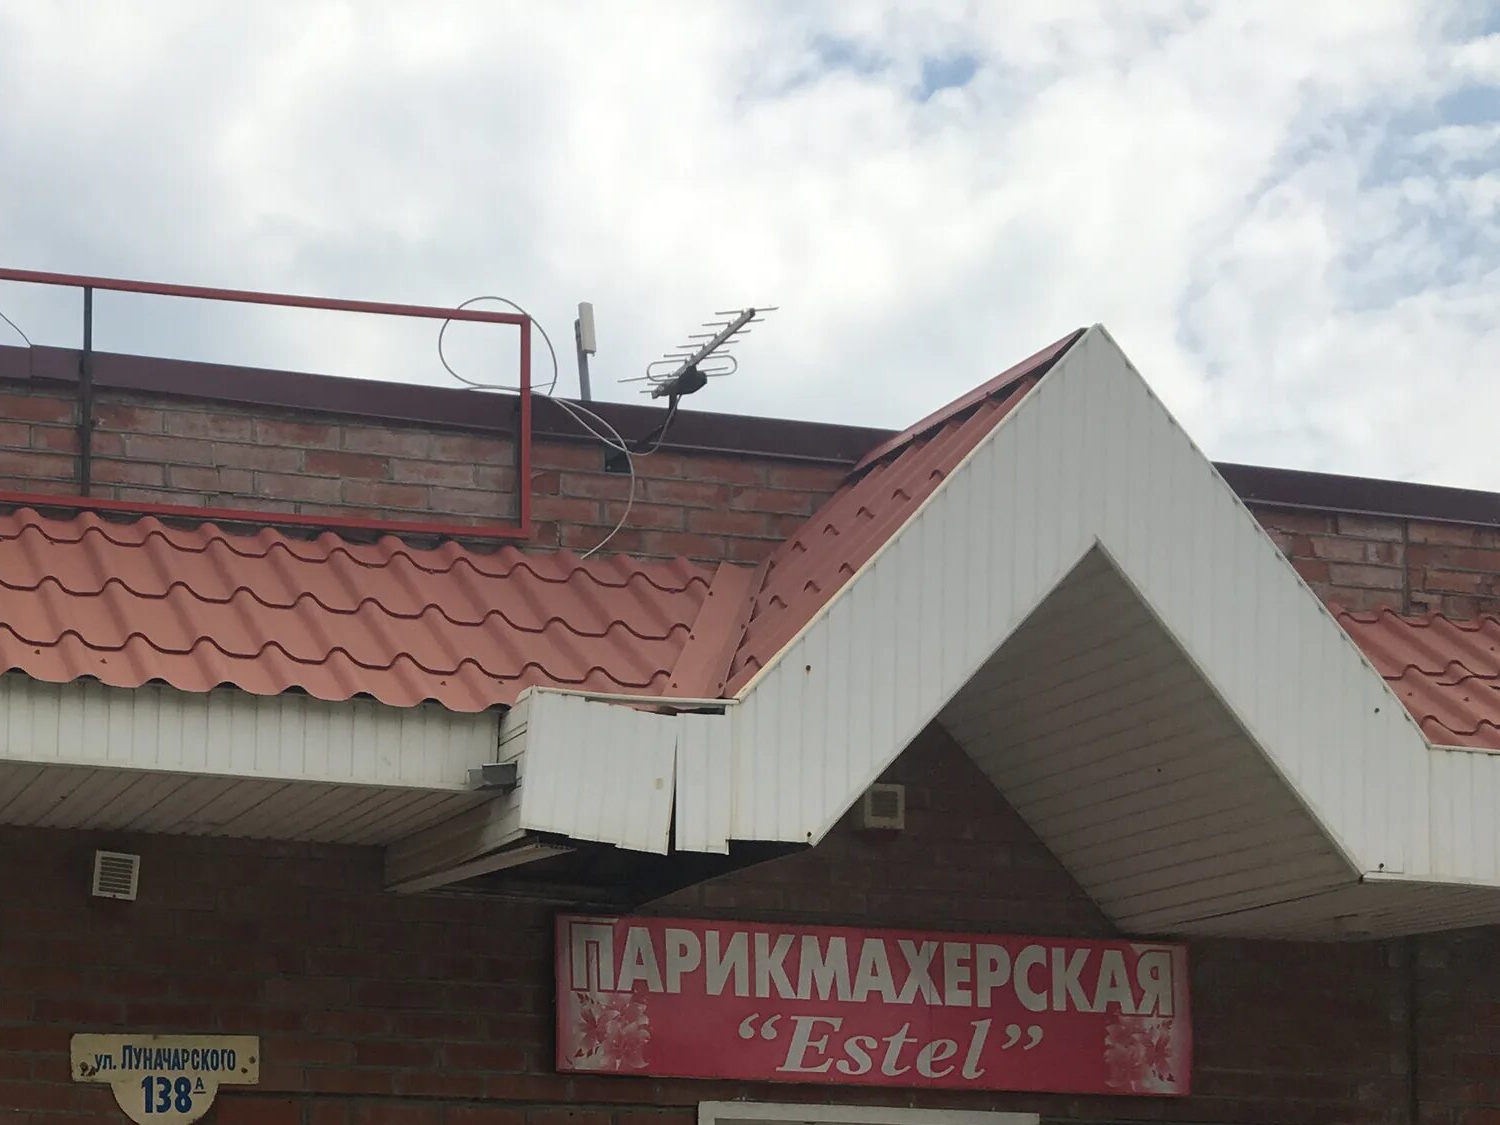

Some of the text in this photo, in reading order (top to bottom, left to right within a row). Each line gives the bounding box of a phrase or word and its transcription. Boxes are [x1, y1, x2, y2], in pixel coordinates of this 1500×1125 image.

[570, 921, 1177, 1018] ПАРИКМАХЕРСКАЯ
[95, 1054, 117, 1072] ул.
[737, 1012, 1044, 1080] “Estel”
